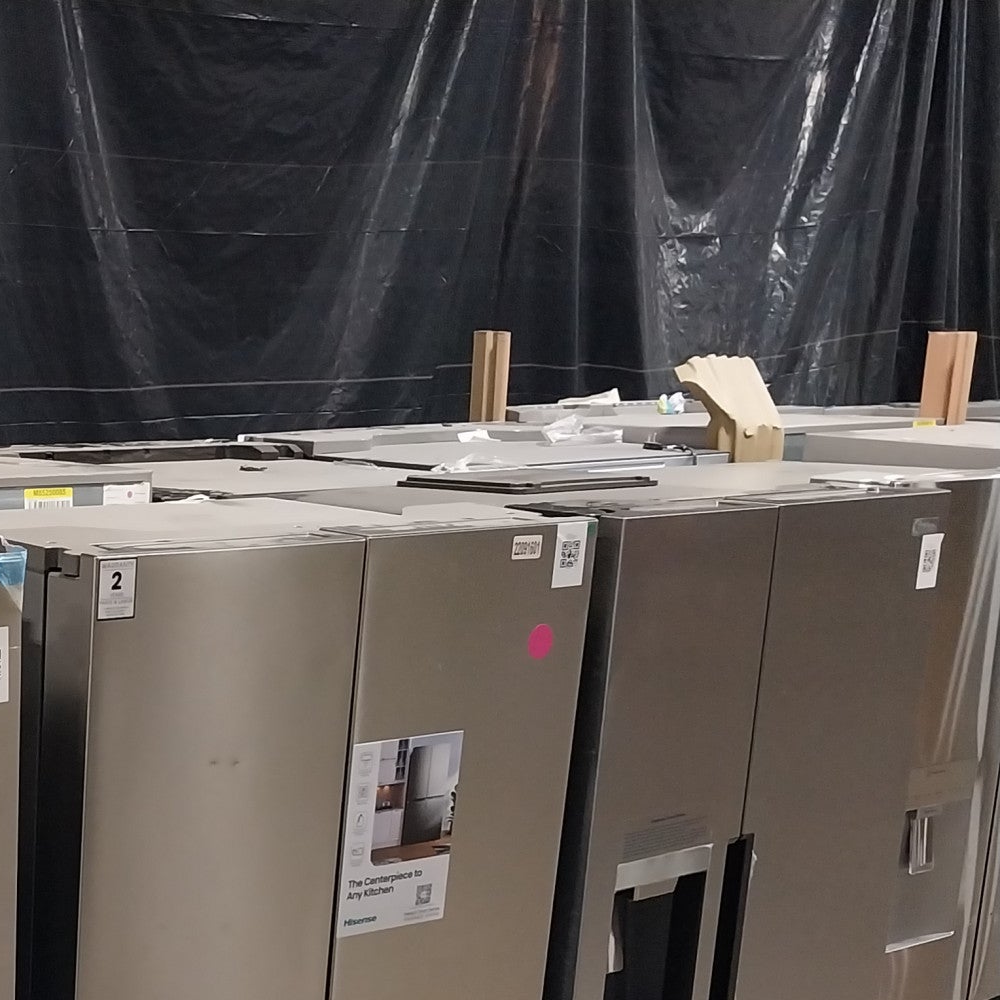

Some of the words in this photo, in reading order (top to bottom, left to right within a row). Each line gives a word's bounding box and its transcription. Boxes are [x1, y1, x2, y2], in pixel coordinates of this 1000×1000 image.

[111, 571, 122, 590] 2
[348, 879, 363, 888] The
[364, 871, 413, 885] Centerpiece
[414, 869, 423, 877] to
[347, 891, 363, 901] Any
[363, 885, 394, 897] Kitchen
[344, 915, 377, 927] Hisense
